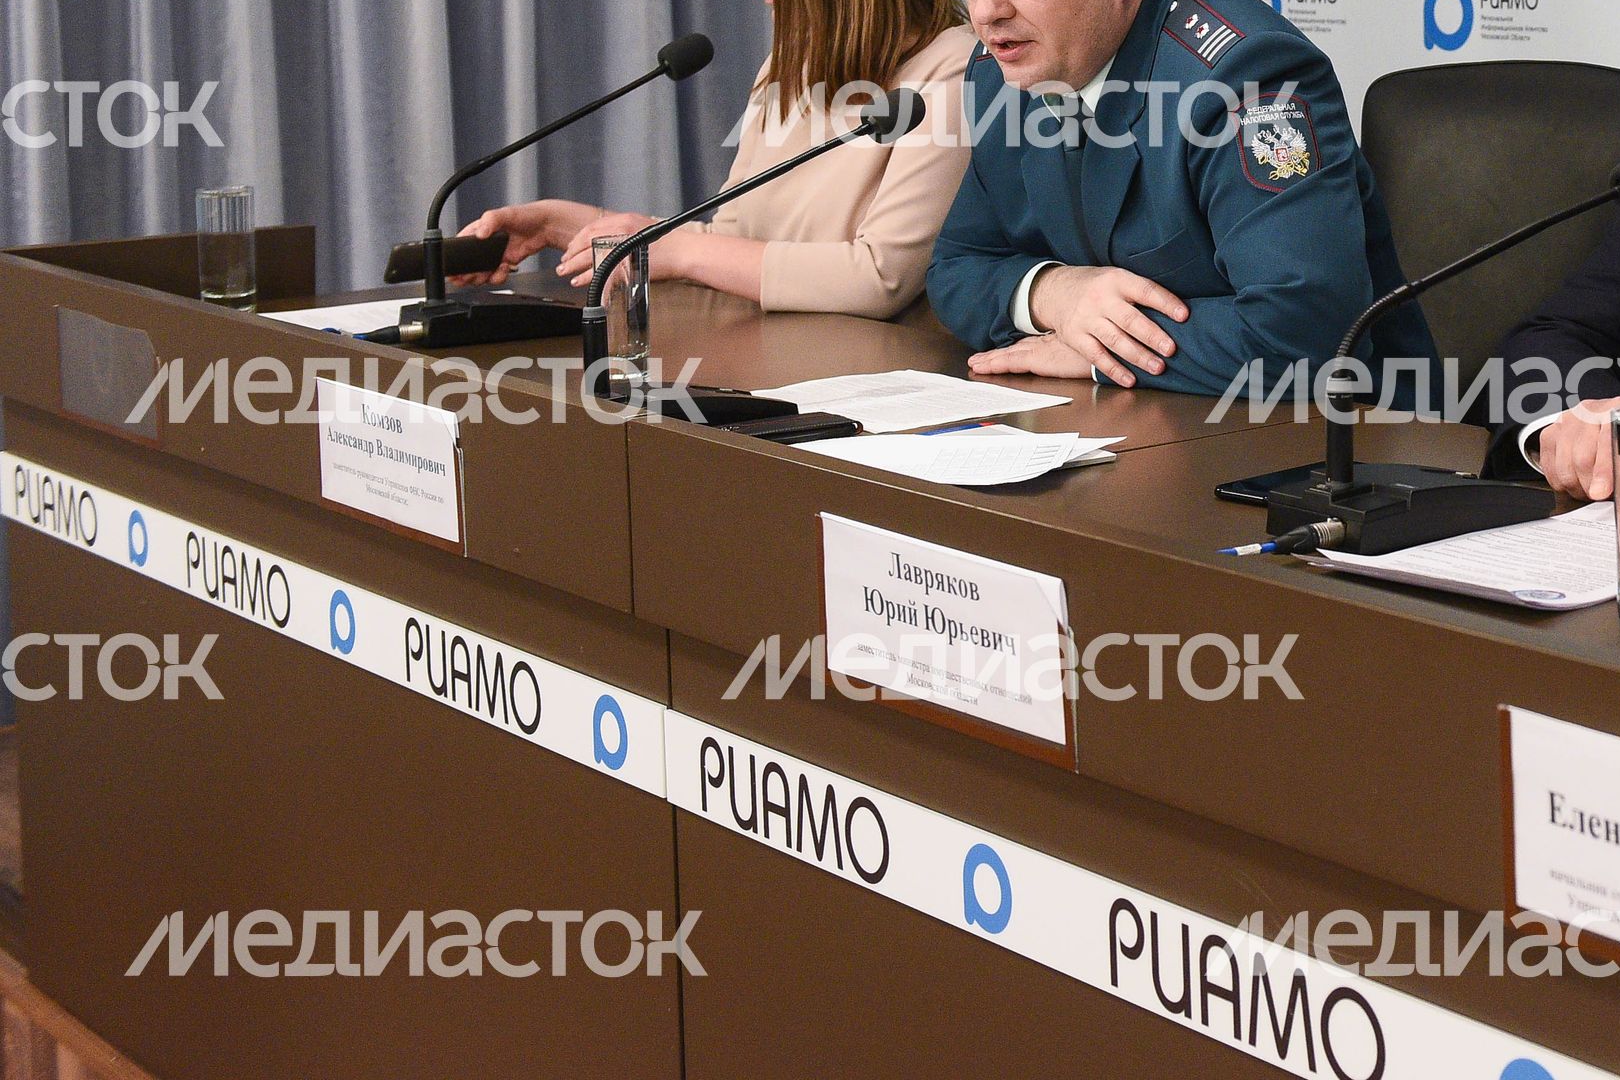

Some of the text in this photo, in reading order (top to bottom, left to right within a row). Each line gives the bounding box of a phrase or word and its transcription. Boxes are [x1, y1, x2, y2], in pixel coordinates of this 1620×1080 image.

[327, 425, 446, 477] Александр Владимирович
[361, 403, 403, 434] Комзов
[14, 464, 98, 548] РИАМО
[185, 530, 291, 630] РИАМО
[888, 551, 981, 602] Лавряков
[863, 585, 1017, 657] Юрий Юрьевич
[404, 616, 542, 735] РИАМО
[700, 735, 890, 886] РИАМО
[1108, 896, 1386, 1080] РИАМО
